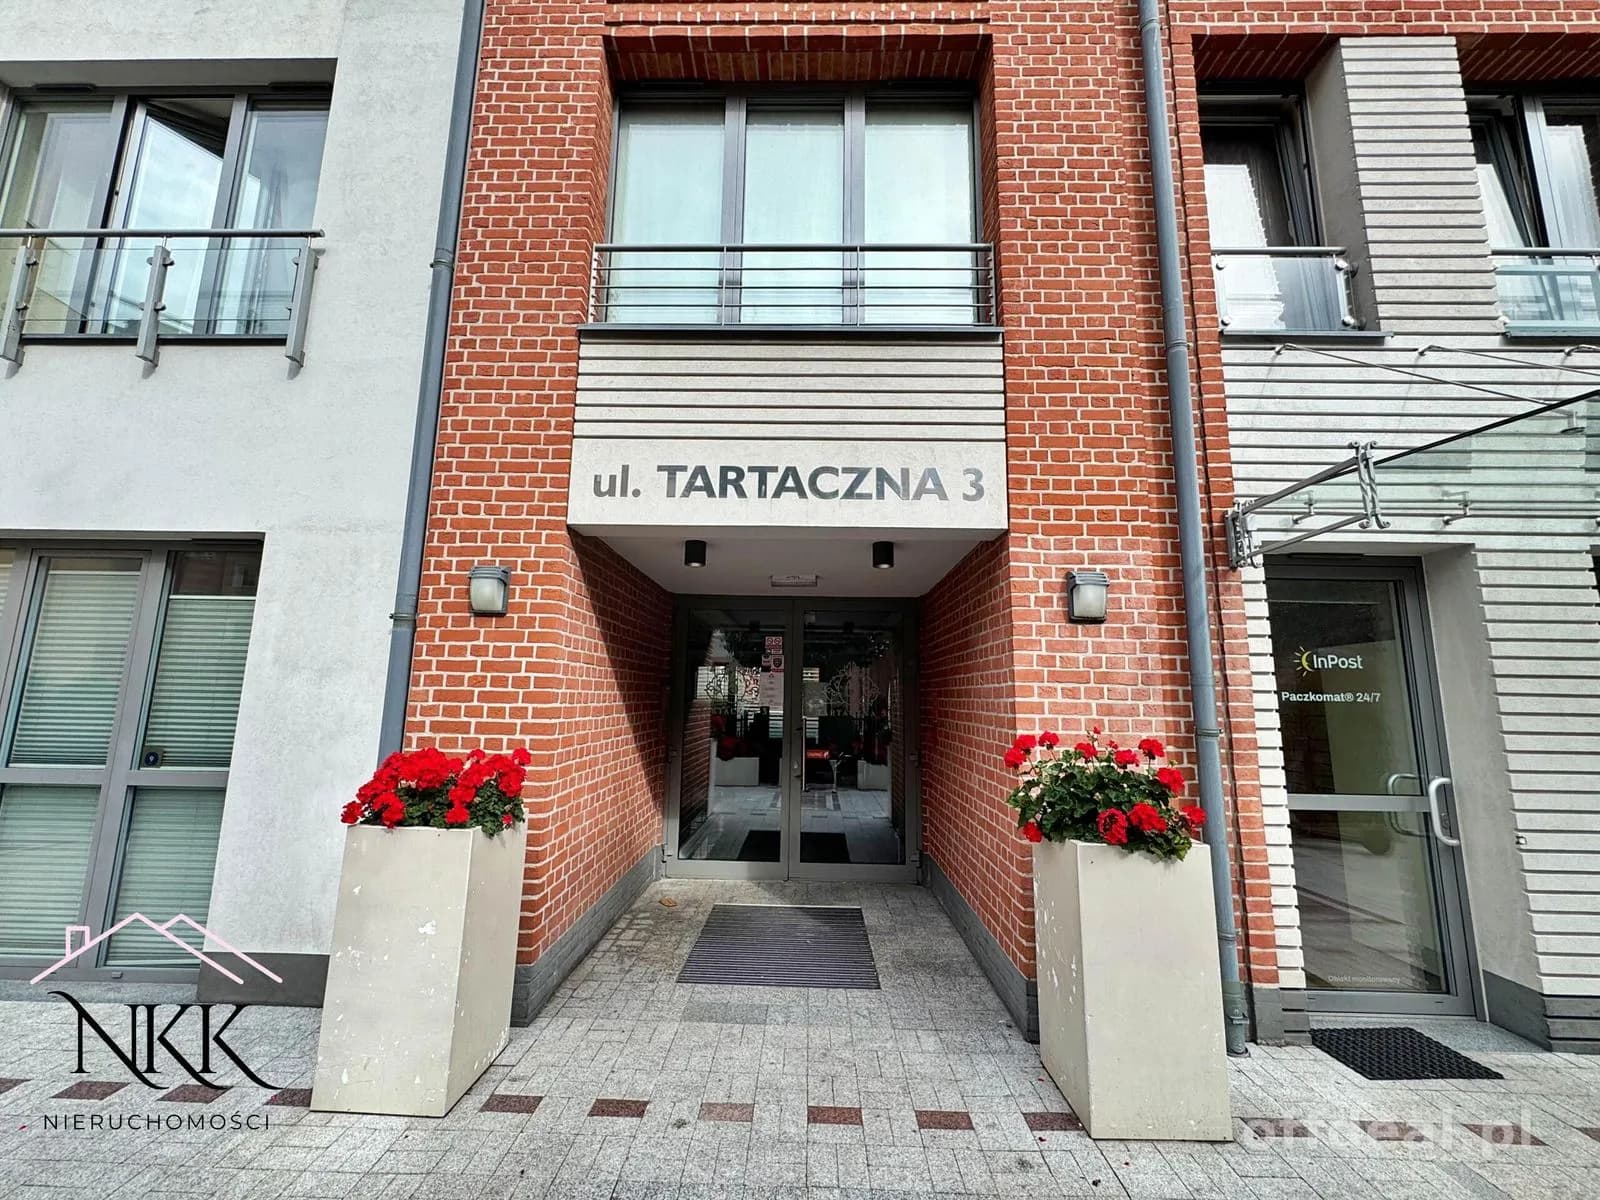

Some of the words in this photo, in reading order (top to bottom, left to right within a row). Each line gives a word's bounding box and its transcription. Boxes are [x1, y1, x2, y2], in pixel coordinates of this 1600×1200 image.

[593, 464, 641, 498] ul.
[656, 465, 950, 501] TARTACZNA
[962, 467, 986, 502] 3
[1313, 654, 1363, 669] InPost
[1356, 692, 1381, 703] 24/7
